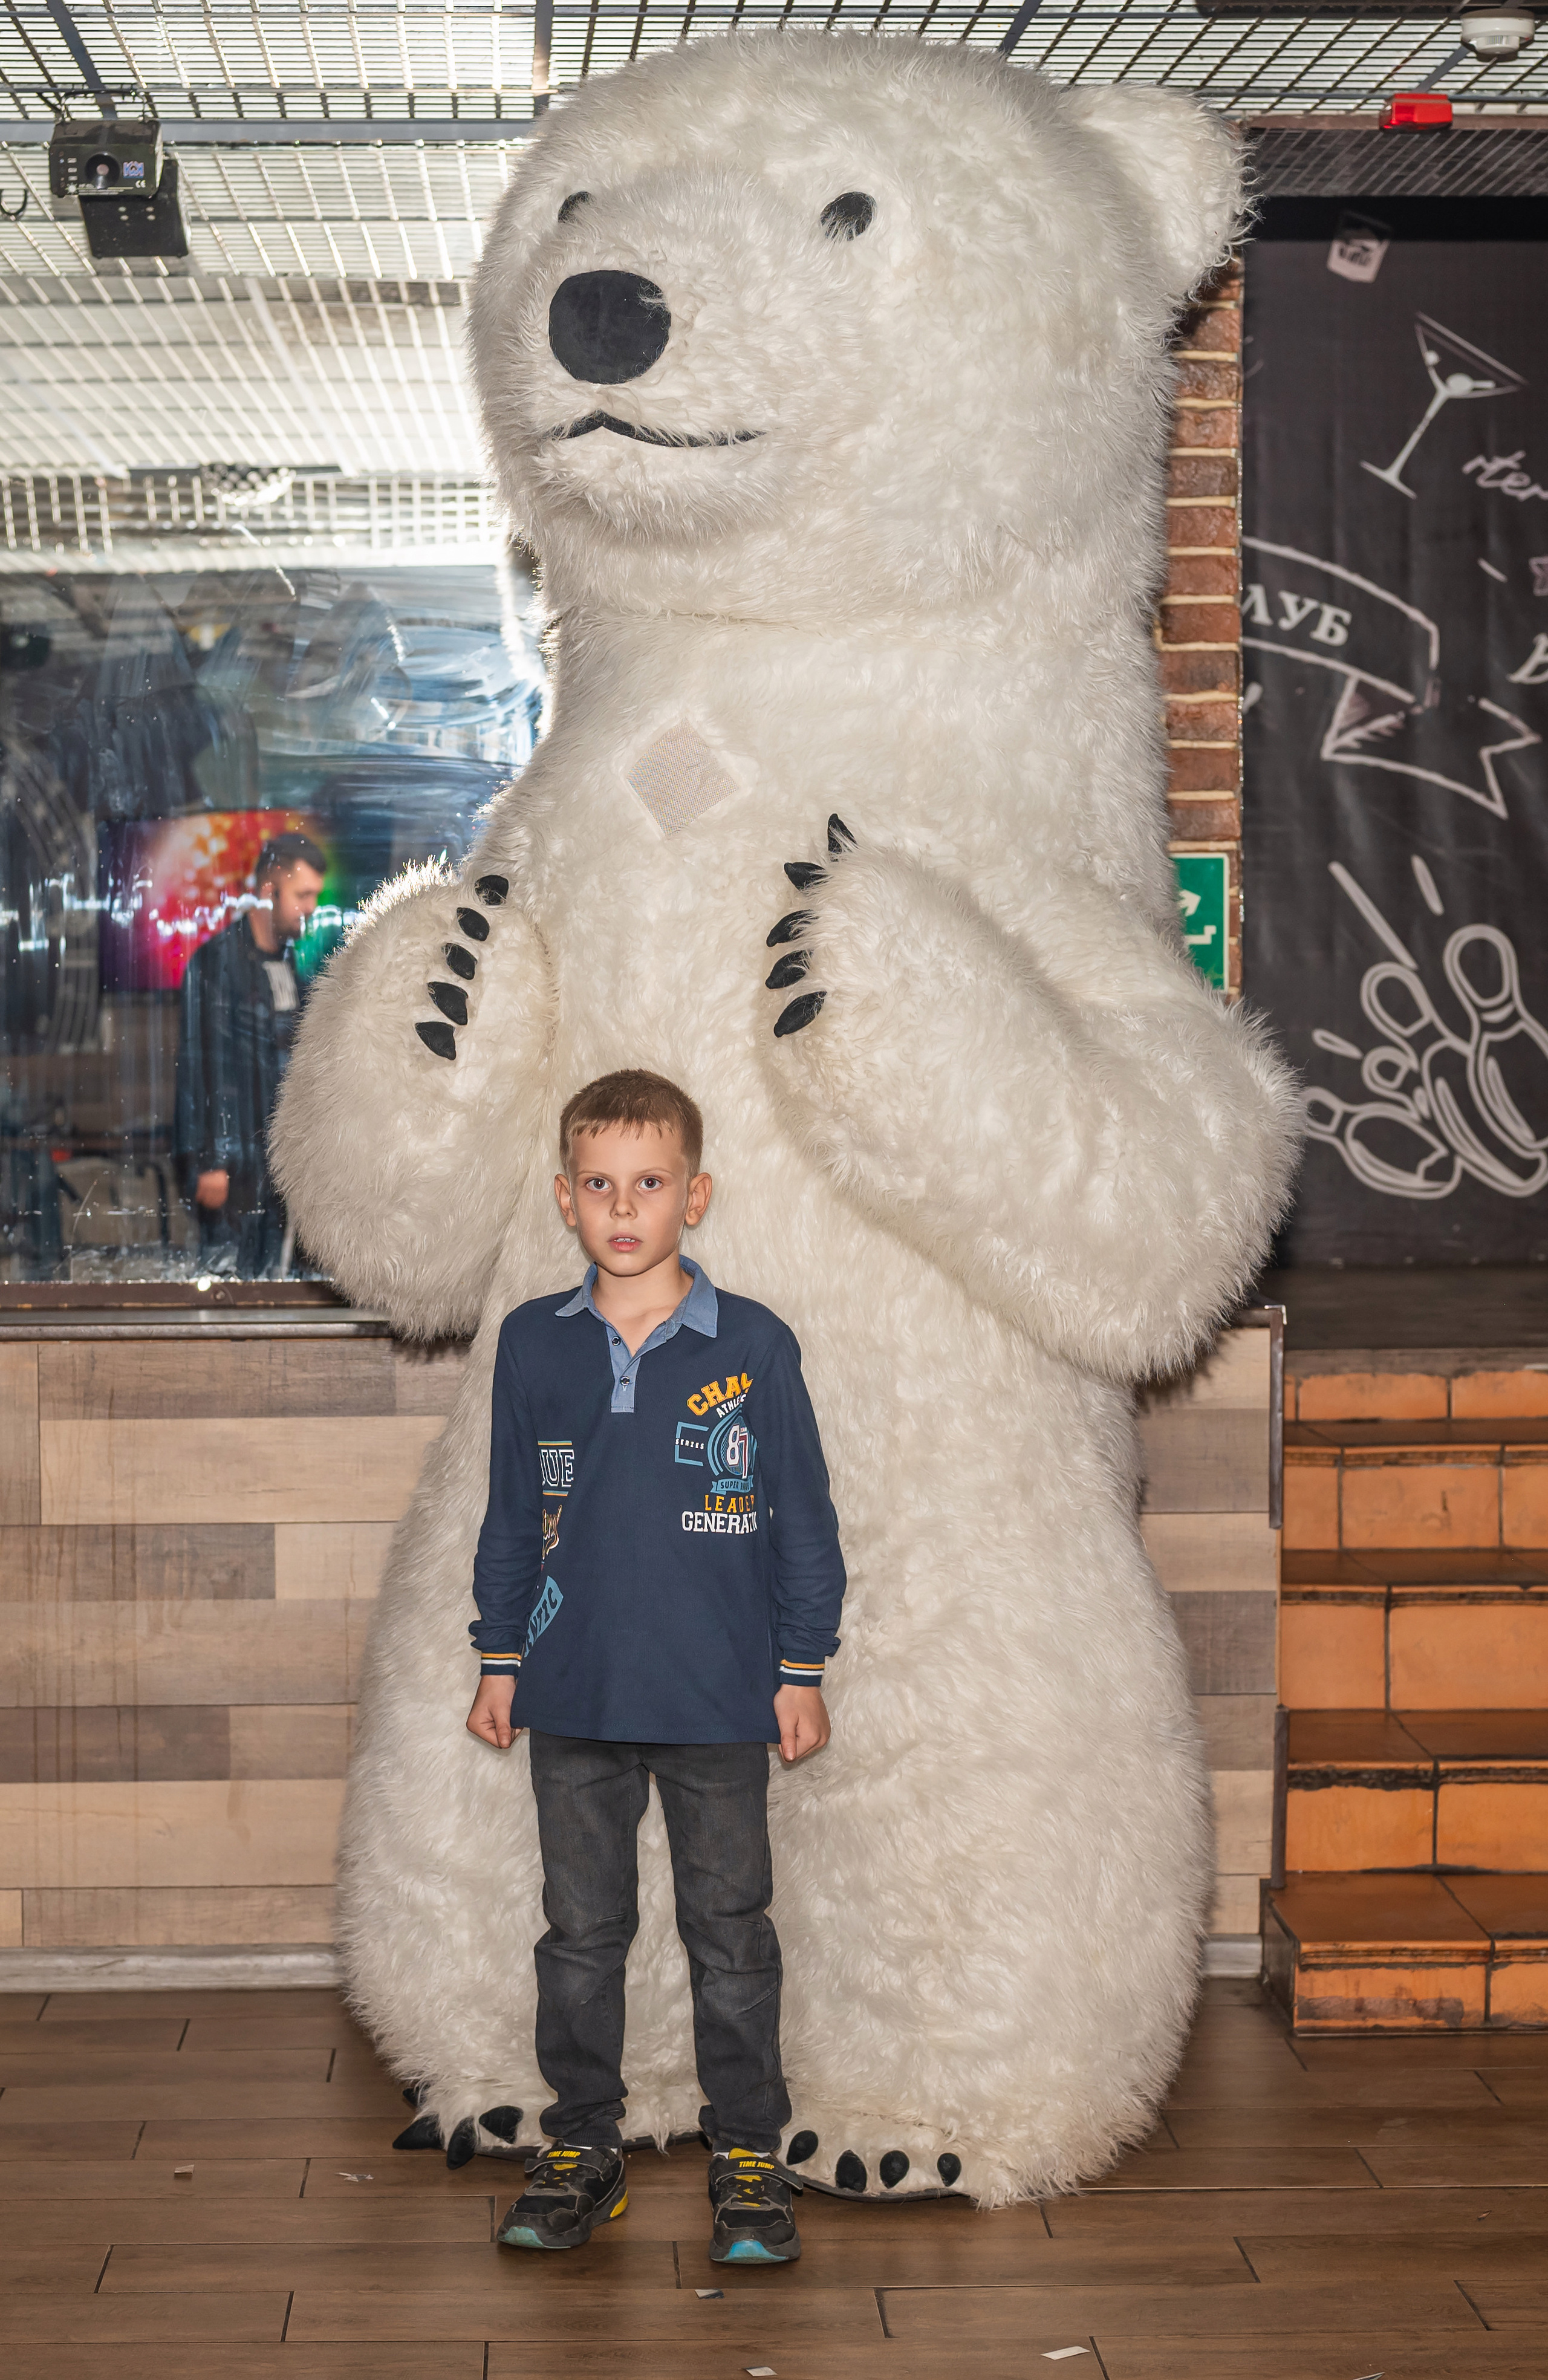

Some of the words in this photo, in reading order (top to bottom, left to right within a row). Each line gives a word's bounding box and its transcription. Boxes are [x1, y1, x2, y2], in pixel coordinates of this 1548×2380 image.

[675, 1438, 704, 1450] SERIES
[539, 1449, 574, 1487] UE
[757, 2161, 775, 2170] JUMP
